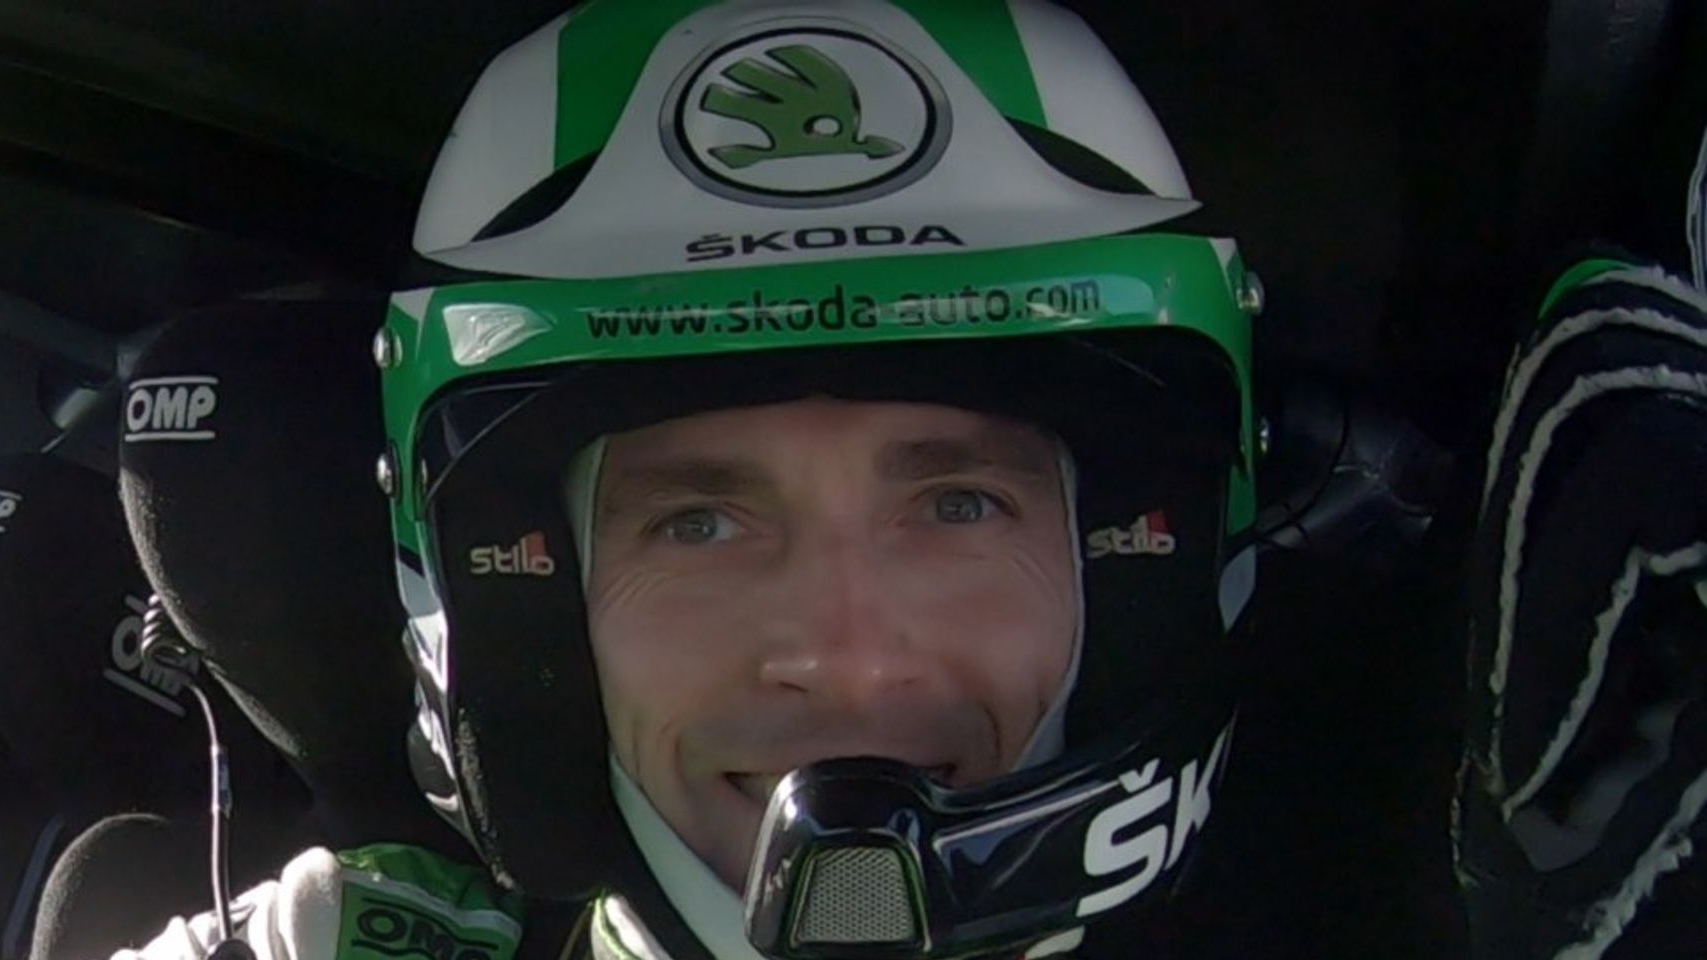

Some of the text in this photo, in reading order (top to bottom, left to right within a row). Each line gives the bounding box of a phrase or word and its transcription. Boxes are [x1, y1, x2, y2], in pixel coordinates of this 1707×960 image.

[685, 223, 965, 262] ŠKODA
[127, 384, 216, 431] OMP
[469, 535, 555, 577] stilo
